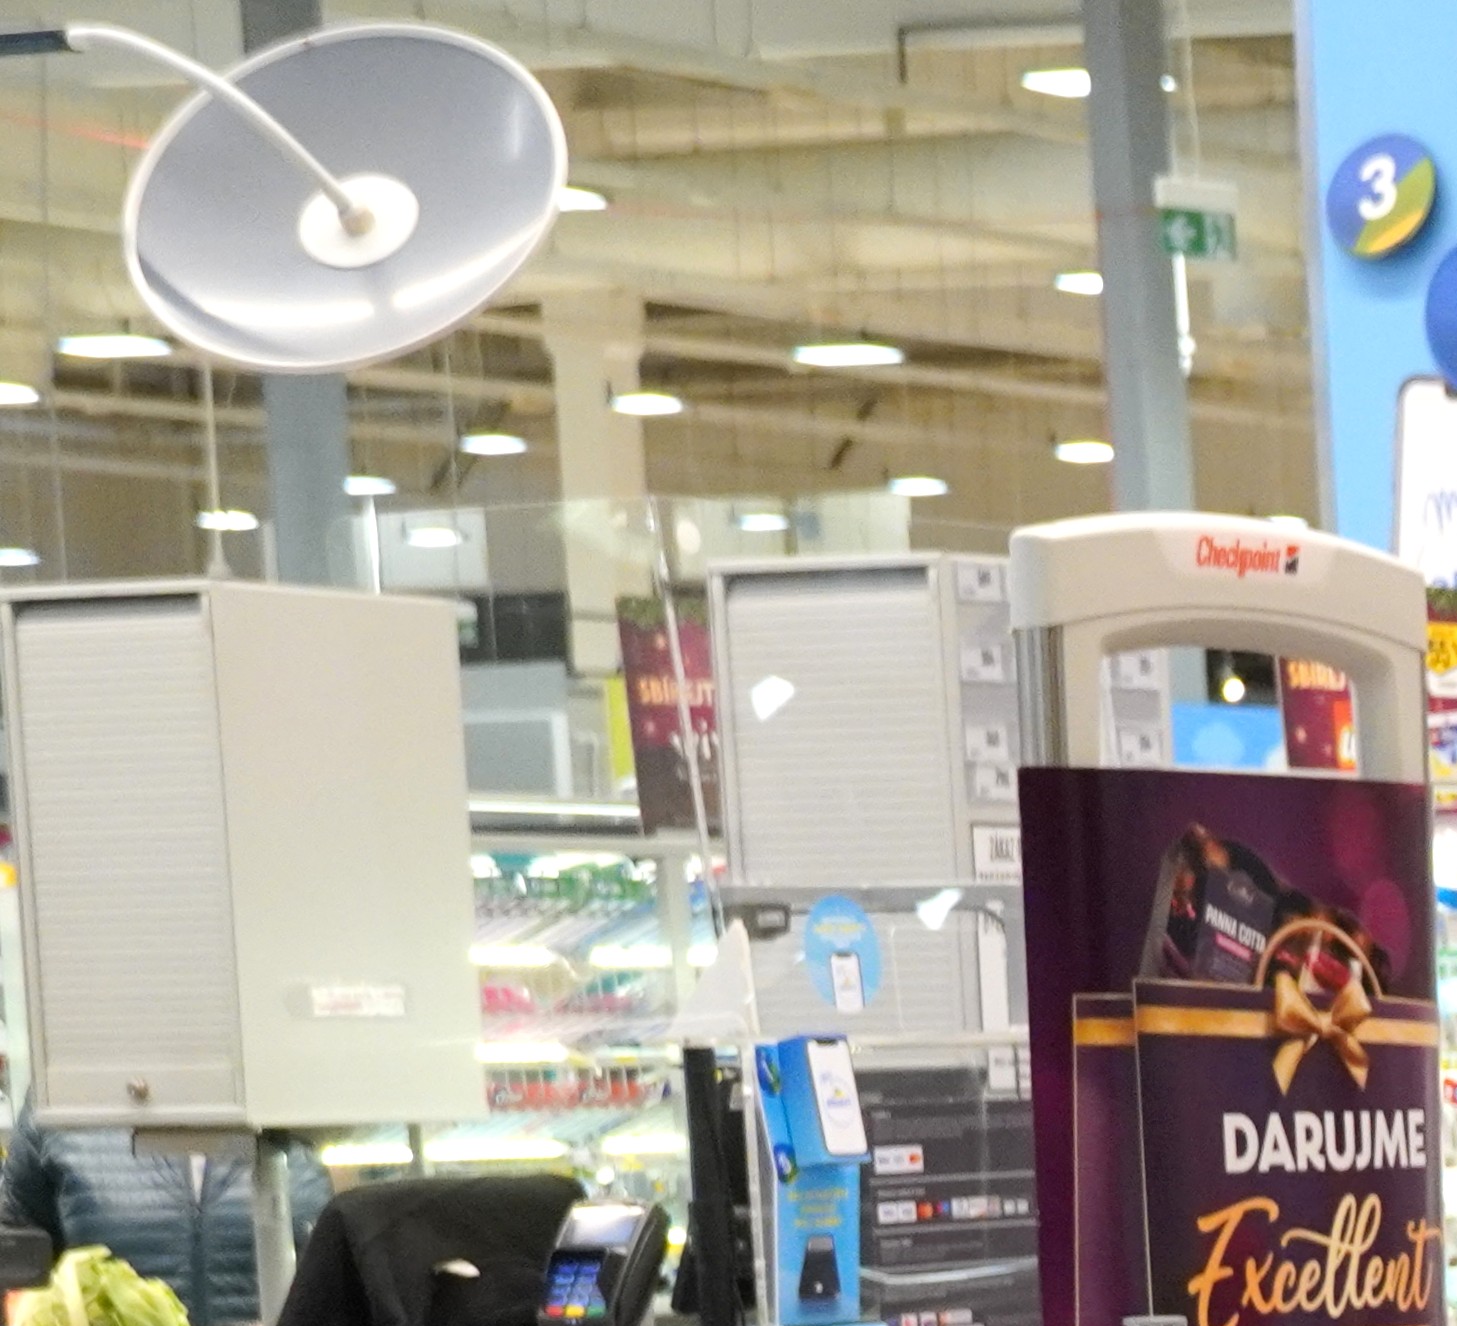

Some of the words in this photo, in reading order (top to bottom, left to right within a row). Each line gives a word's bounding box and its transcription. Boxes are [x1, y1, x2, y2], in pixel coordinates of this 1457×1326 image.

[1357, 153, 1397, 222] 3
[1196, 535, 1280, 577] Checkpoint
[1204, 903, 1238, 939] PANNA
[1223, 1108, 1427, 1175] DARUJME
